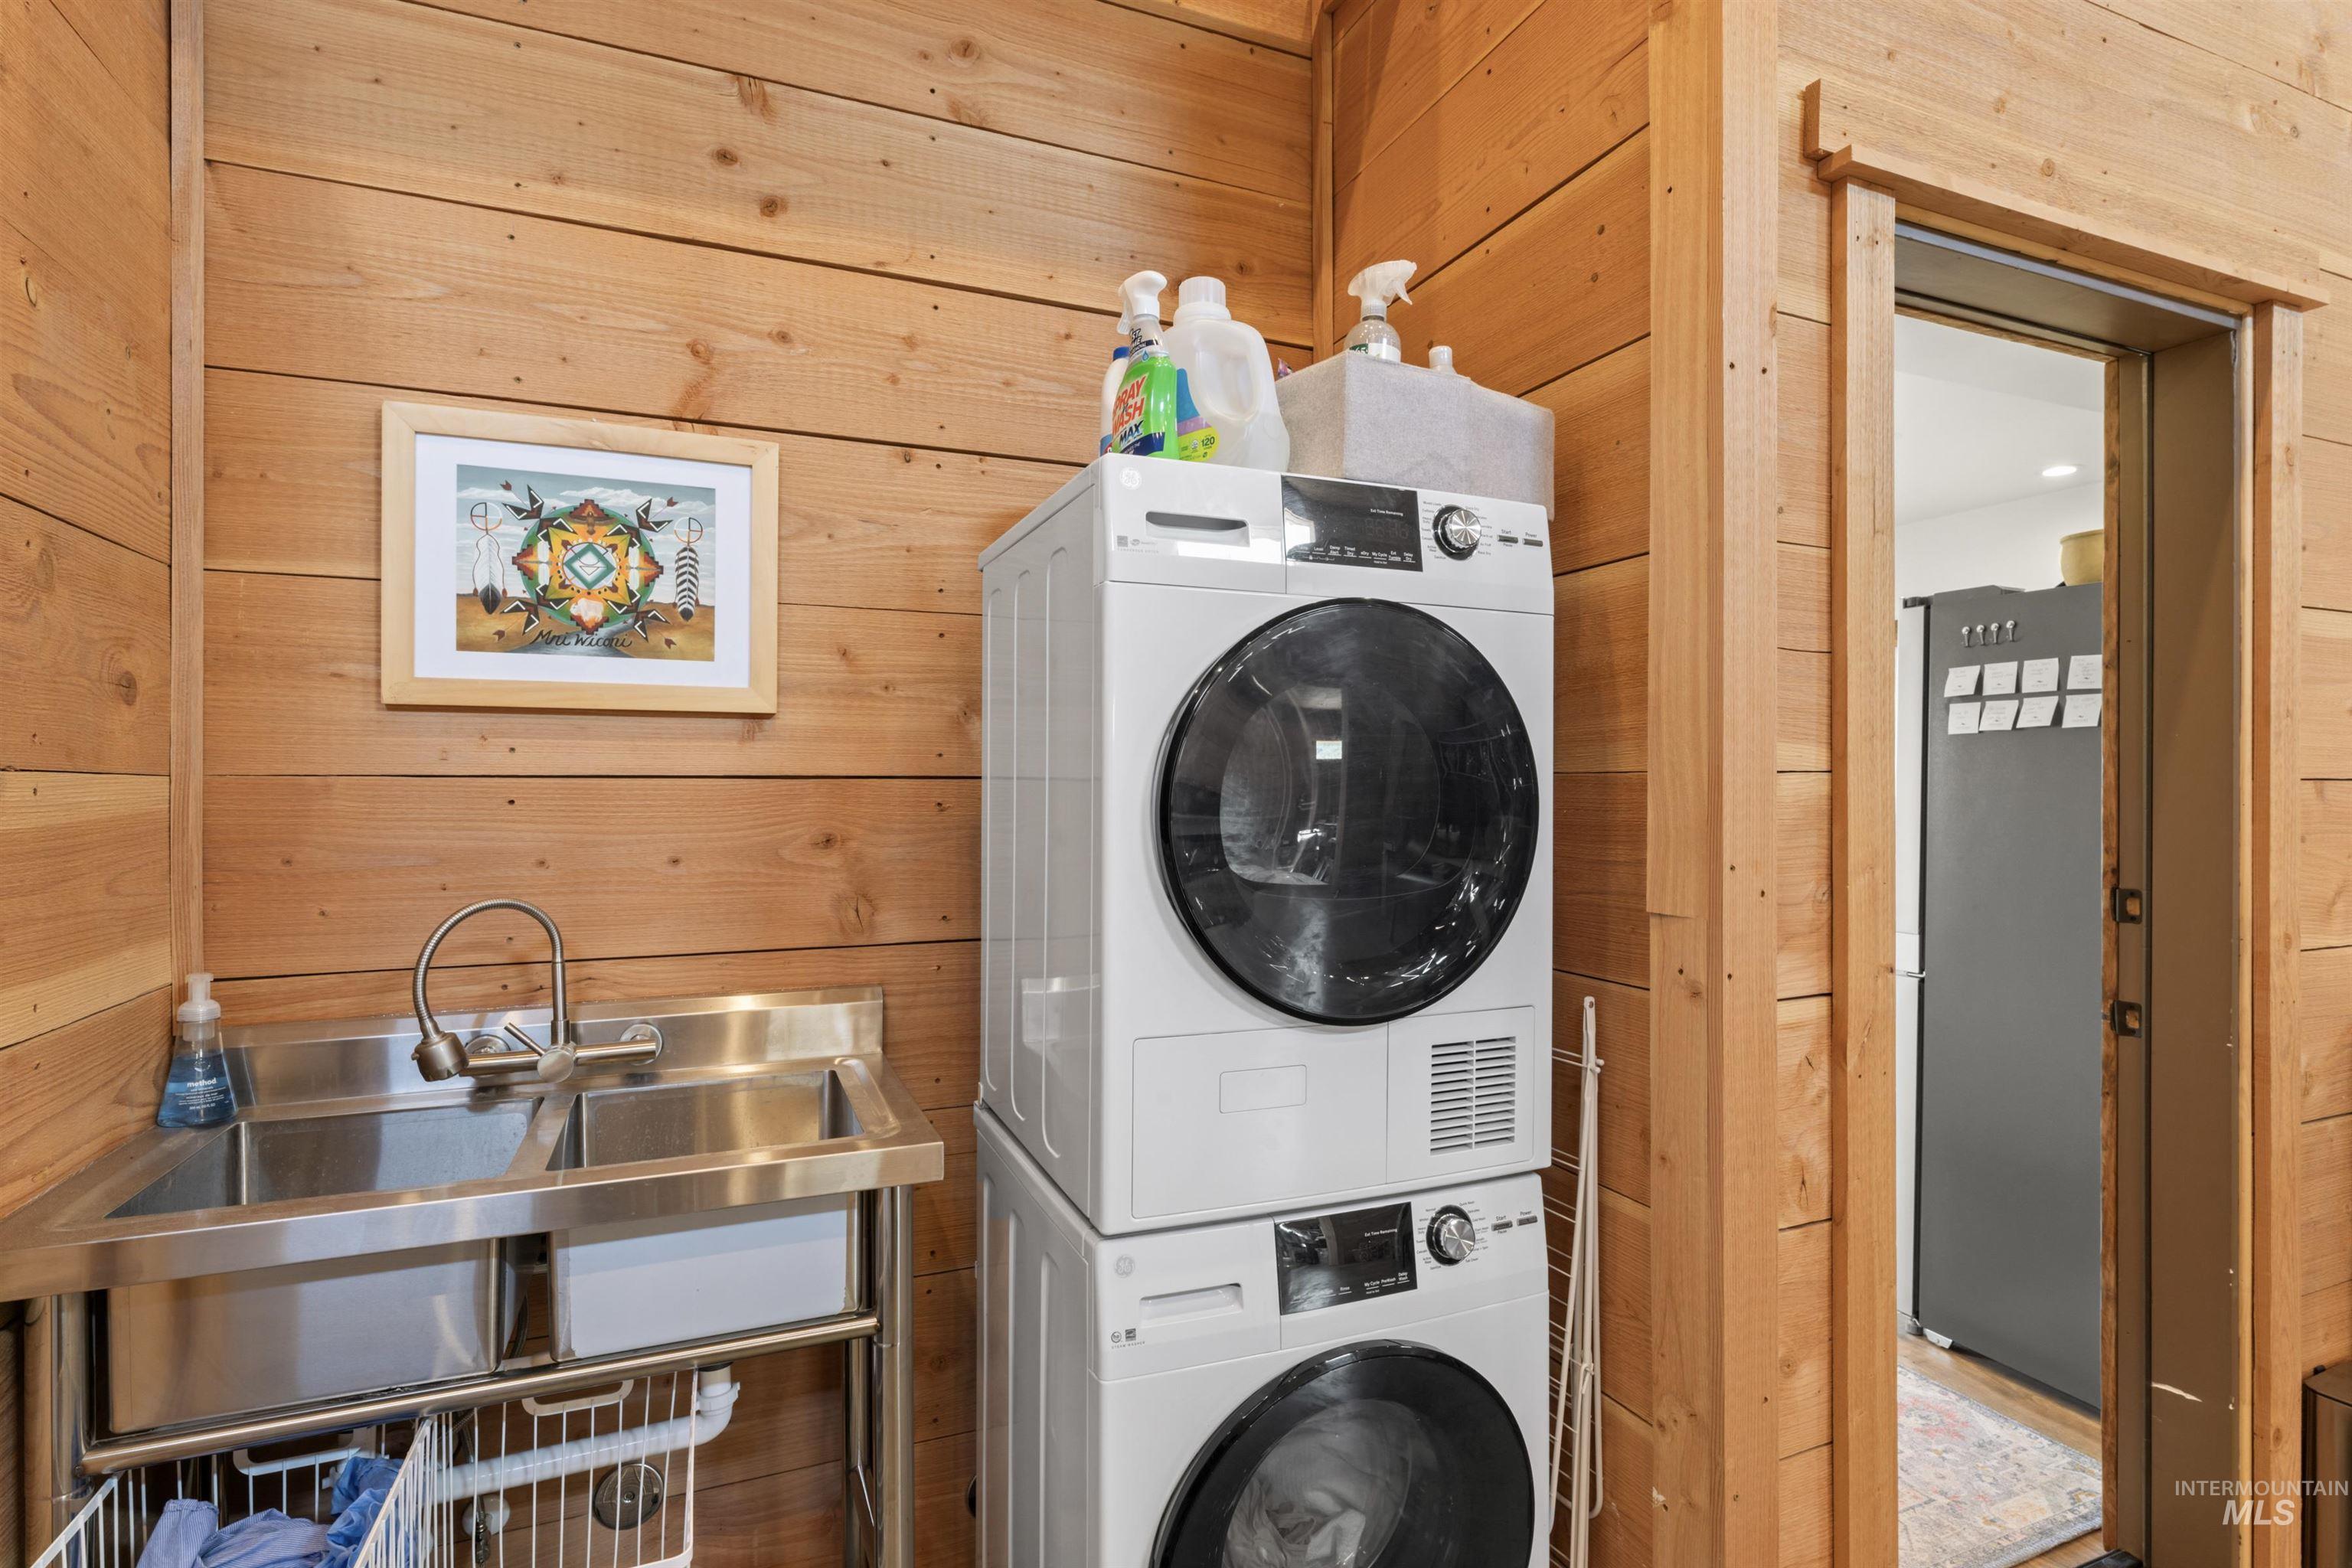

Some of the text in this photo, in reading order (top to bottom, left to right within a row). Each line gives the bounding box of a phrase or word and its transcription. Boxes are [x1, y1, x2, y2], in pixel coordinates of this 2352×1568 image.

[1119, 420, 1145, 446] MAX
[1201, 436, 1215, 447] 120
[574, 633, 632, 648] Wiconi
[187, 1077, 217, 1087] method
